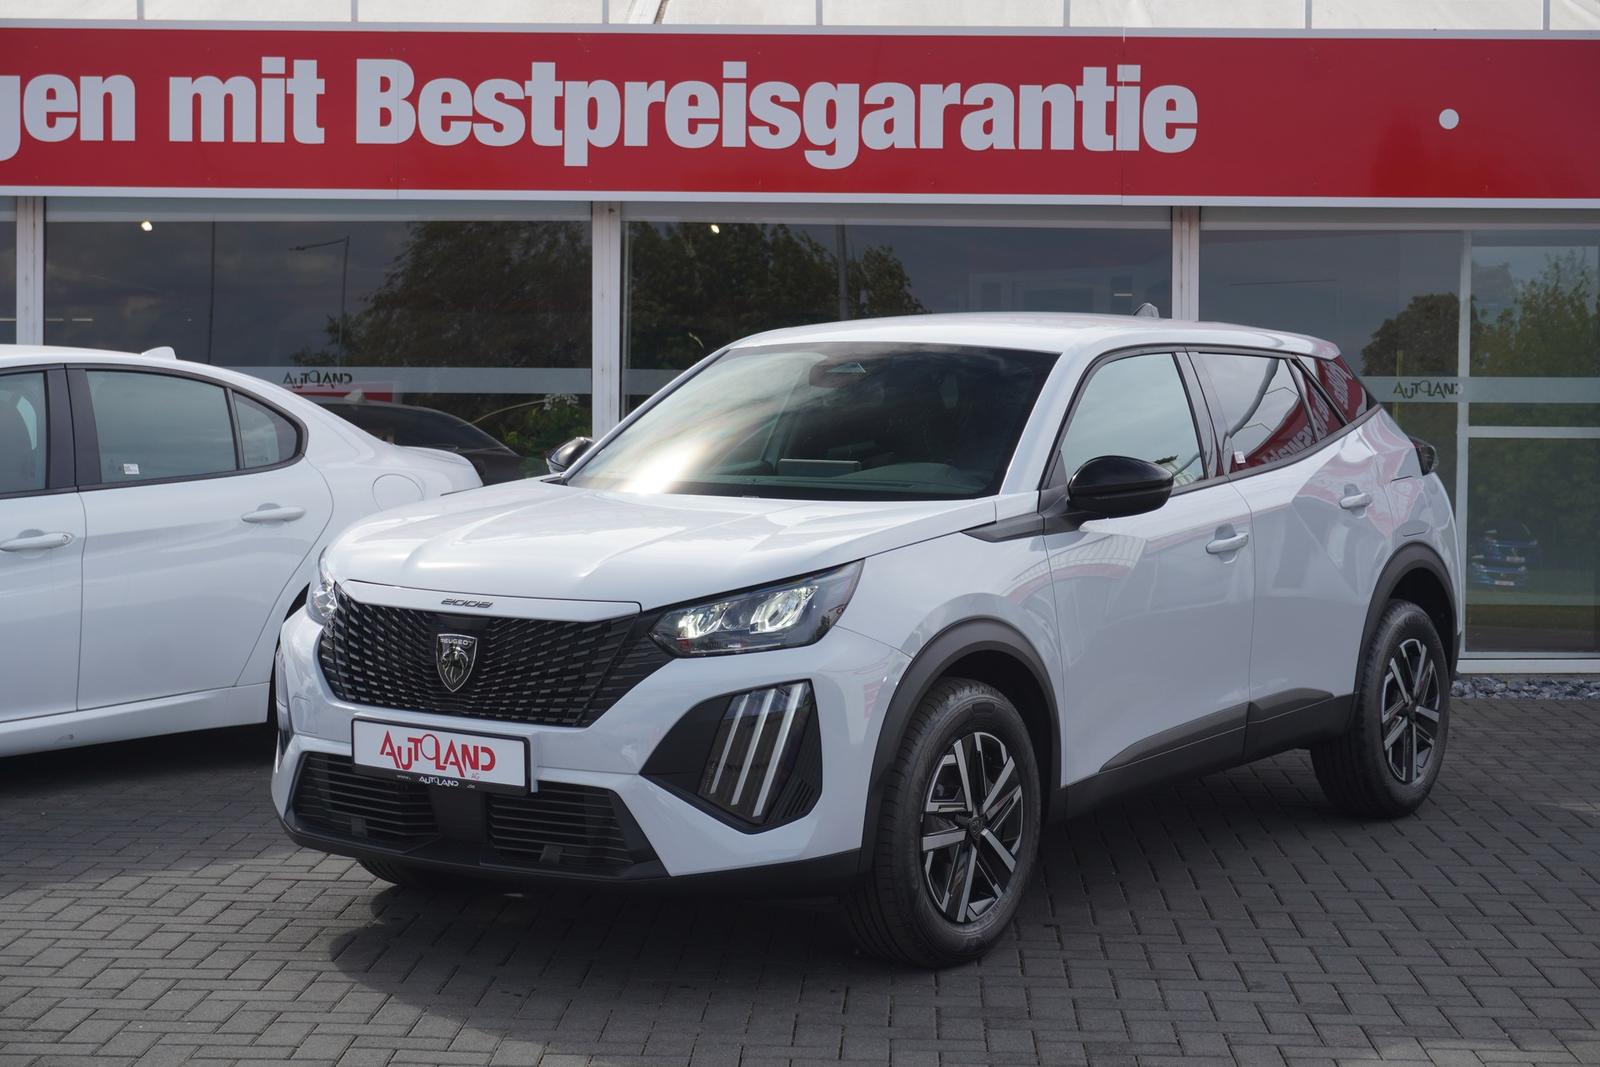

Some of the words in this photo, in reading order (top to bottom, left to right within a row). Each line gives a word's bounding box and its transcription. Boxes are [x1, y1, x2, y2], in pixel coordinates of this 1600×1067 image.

[169, 57, 324, 144] mit
[356, 59, 1197, 169] Bestpreisgarantie
[441, 598, 493, 609] 2008
[380, 729, 496, 777] AUTOLAND
[418, 775, 460, 787] AUTOLAND
